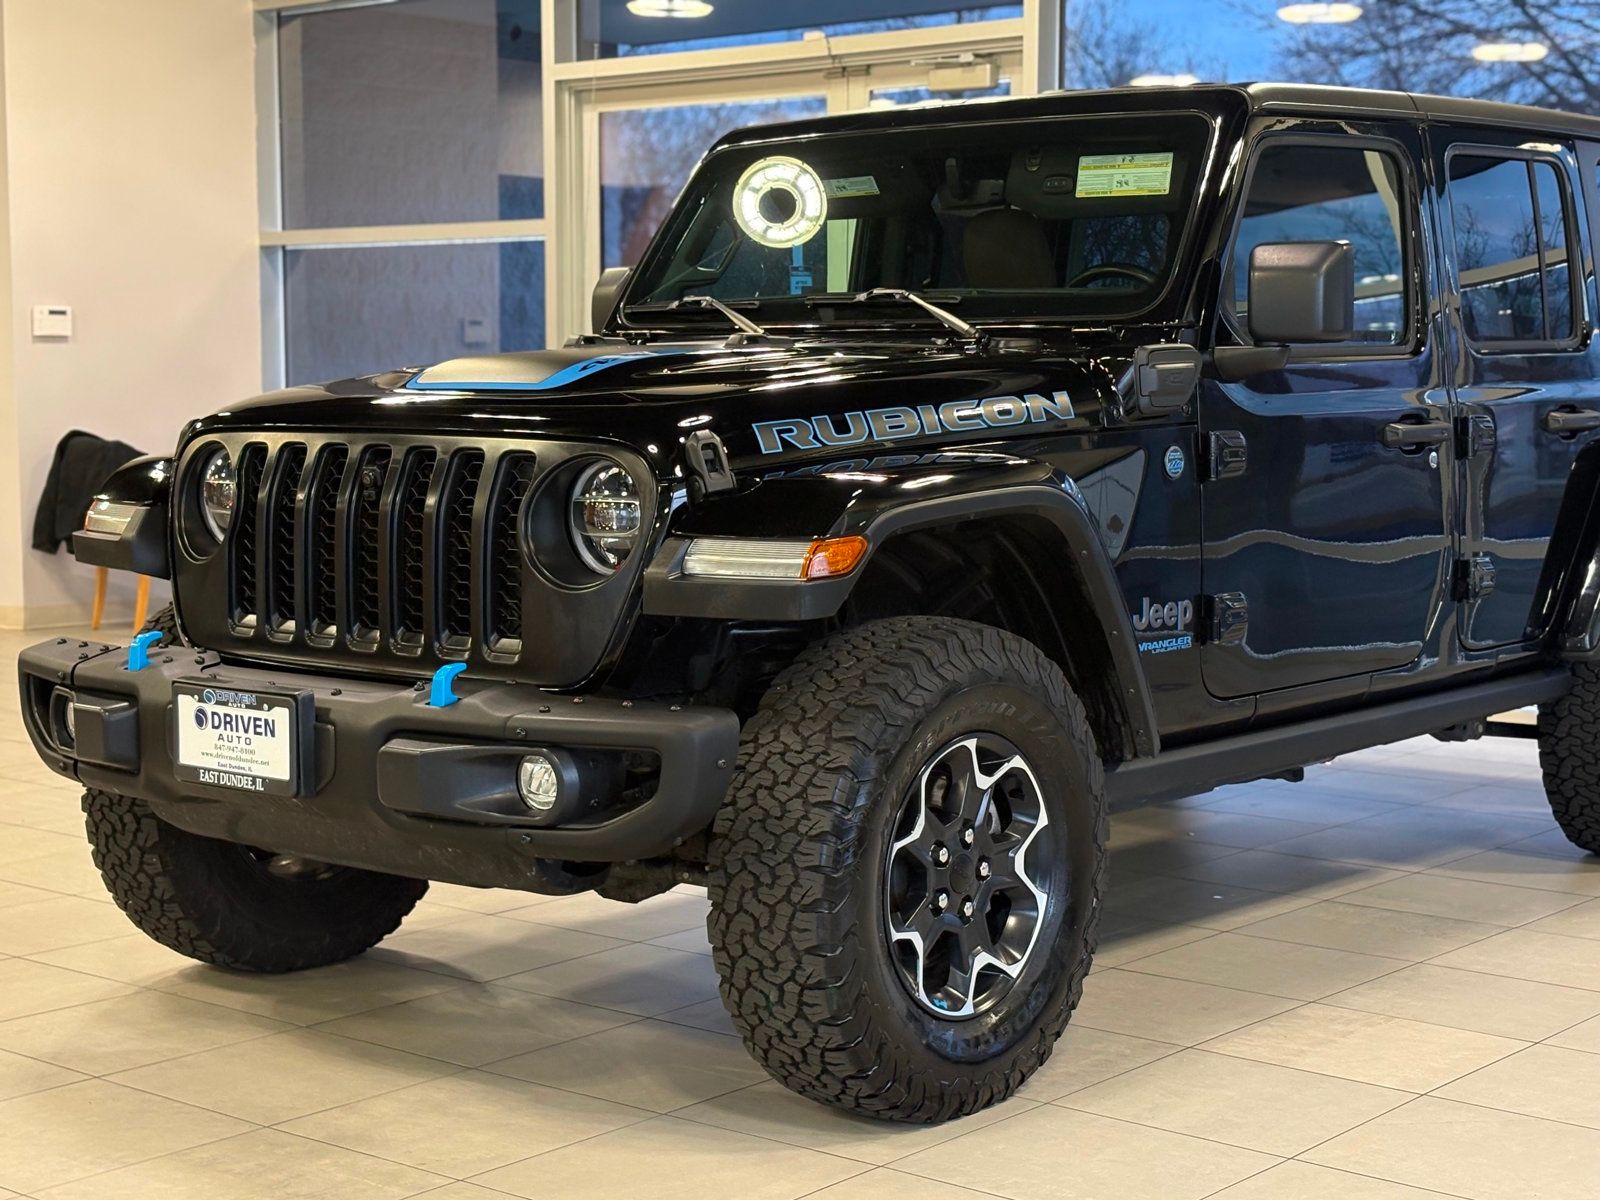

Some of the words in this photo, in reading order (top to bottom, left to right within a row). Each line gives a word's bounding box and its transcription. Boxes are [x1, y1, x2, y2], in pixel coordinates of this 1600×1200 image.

[752, 391, 1075, 454] RUBICON
[1132, 596, 1193, 631] Jeep
[215, 690, 257, 705] DRIVEN
[211, 711, 276, 738] DRIVEN
[217, 733, 252, 746] AUTO
[200, 769, 219, 784] EAST
[220, 773, 255, 790] DUNDEE,
[255, 779, 264, 791] IL
